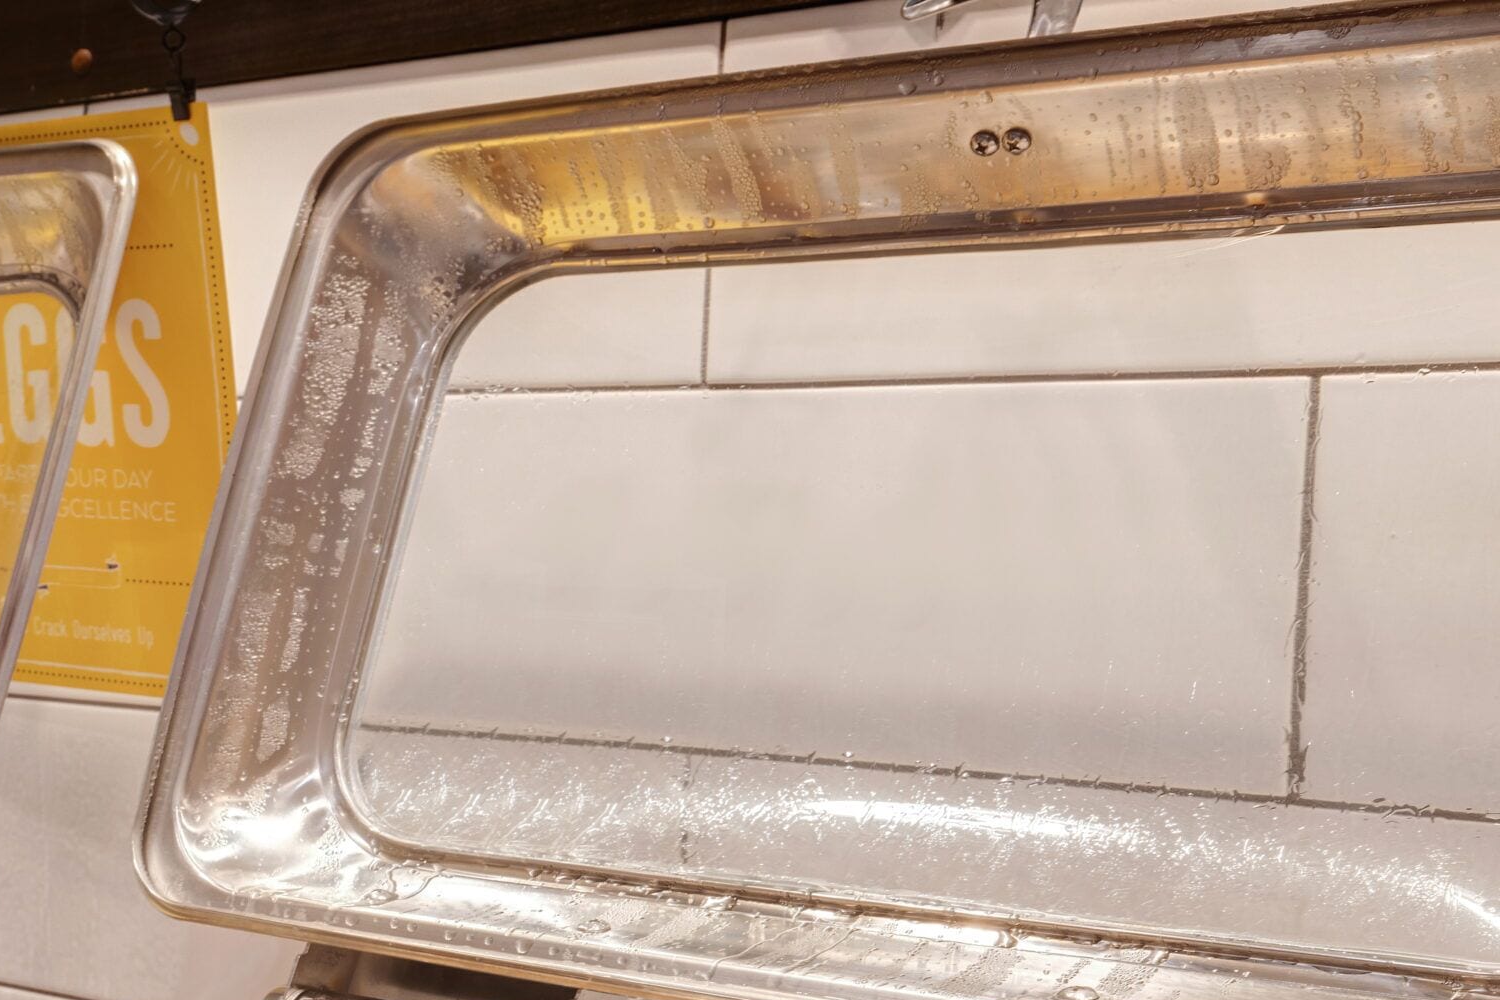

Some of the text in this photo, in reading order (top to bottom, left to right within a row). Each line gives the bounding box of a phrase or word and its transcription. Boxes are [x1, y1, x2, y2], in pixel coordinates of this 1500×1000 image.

[64, 467, 108, 489] OUR
[114, 469, 153, 489] DAY
[33, 616, 67, 637] Crack
[137, 625, 155, 651] Up
